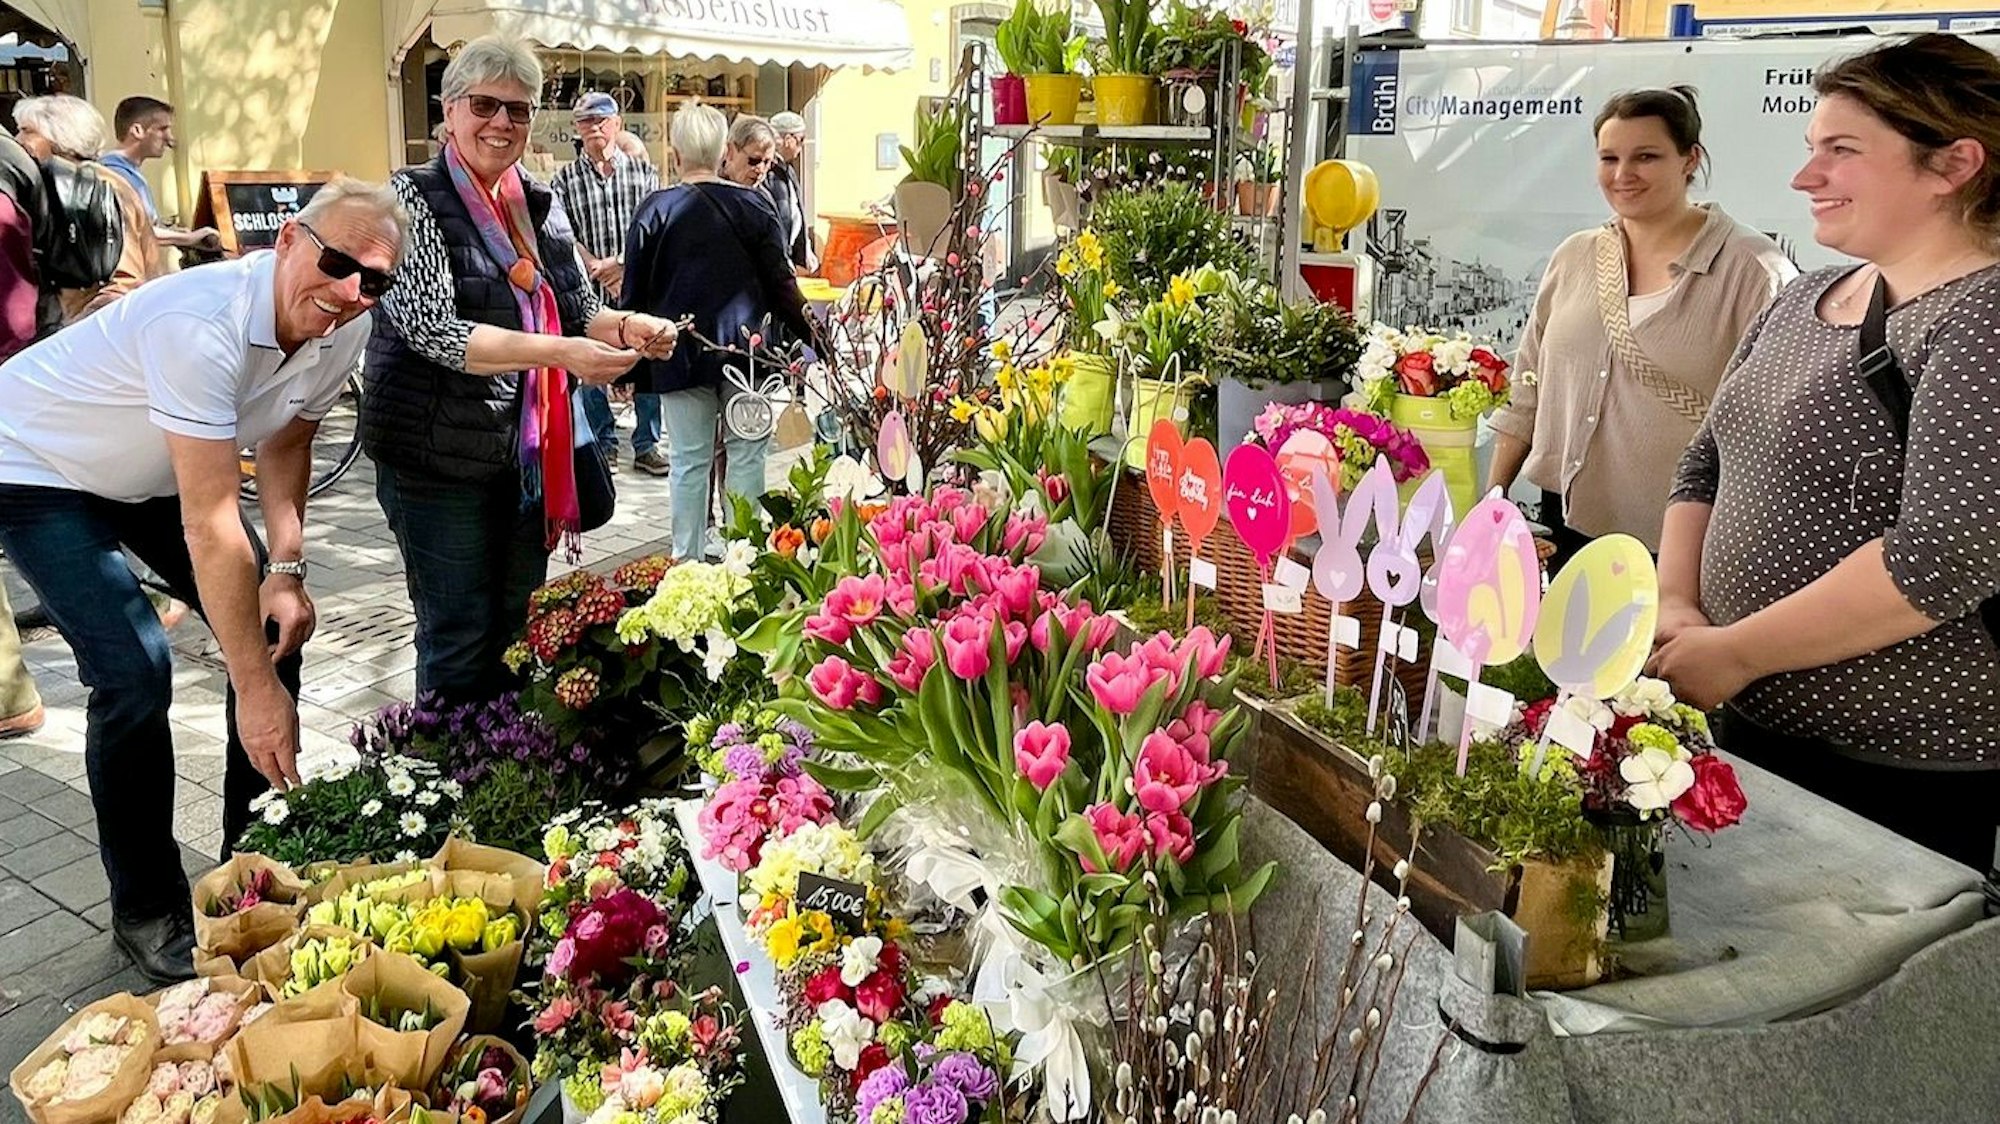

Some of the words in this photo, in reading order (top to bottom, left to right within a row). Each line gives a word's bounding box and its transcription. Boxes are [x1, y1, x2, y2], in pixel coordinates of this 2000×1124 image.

[1372, 75, 1396, 131] Brühl
[1405, 95, 1583, 120] CityManagement
[233, 211, 297, 232] SCHLOS
[806, 885, 864, 917] 15,00€
